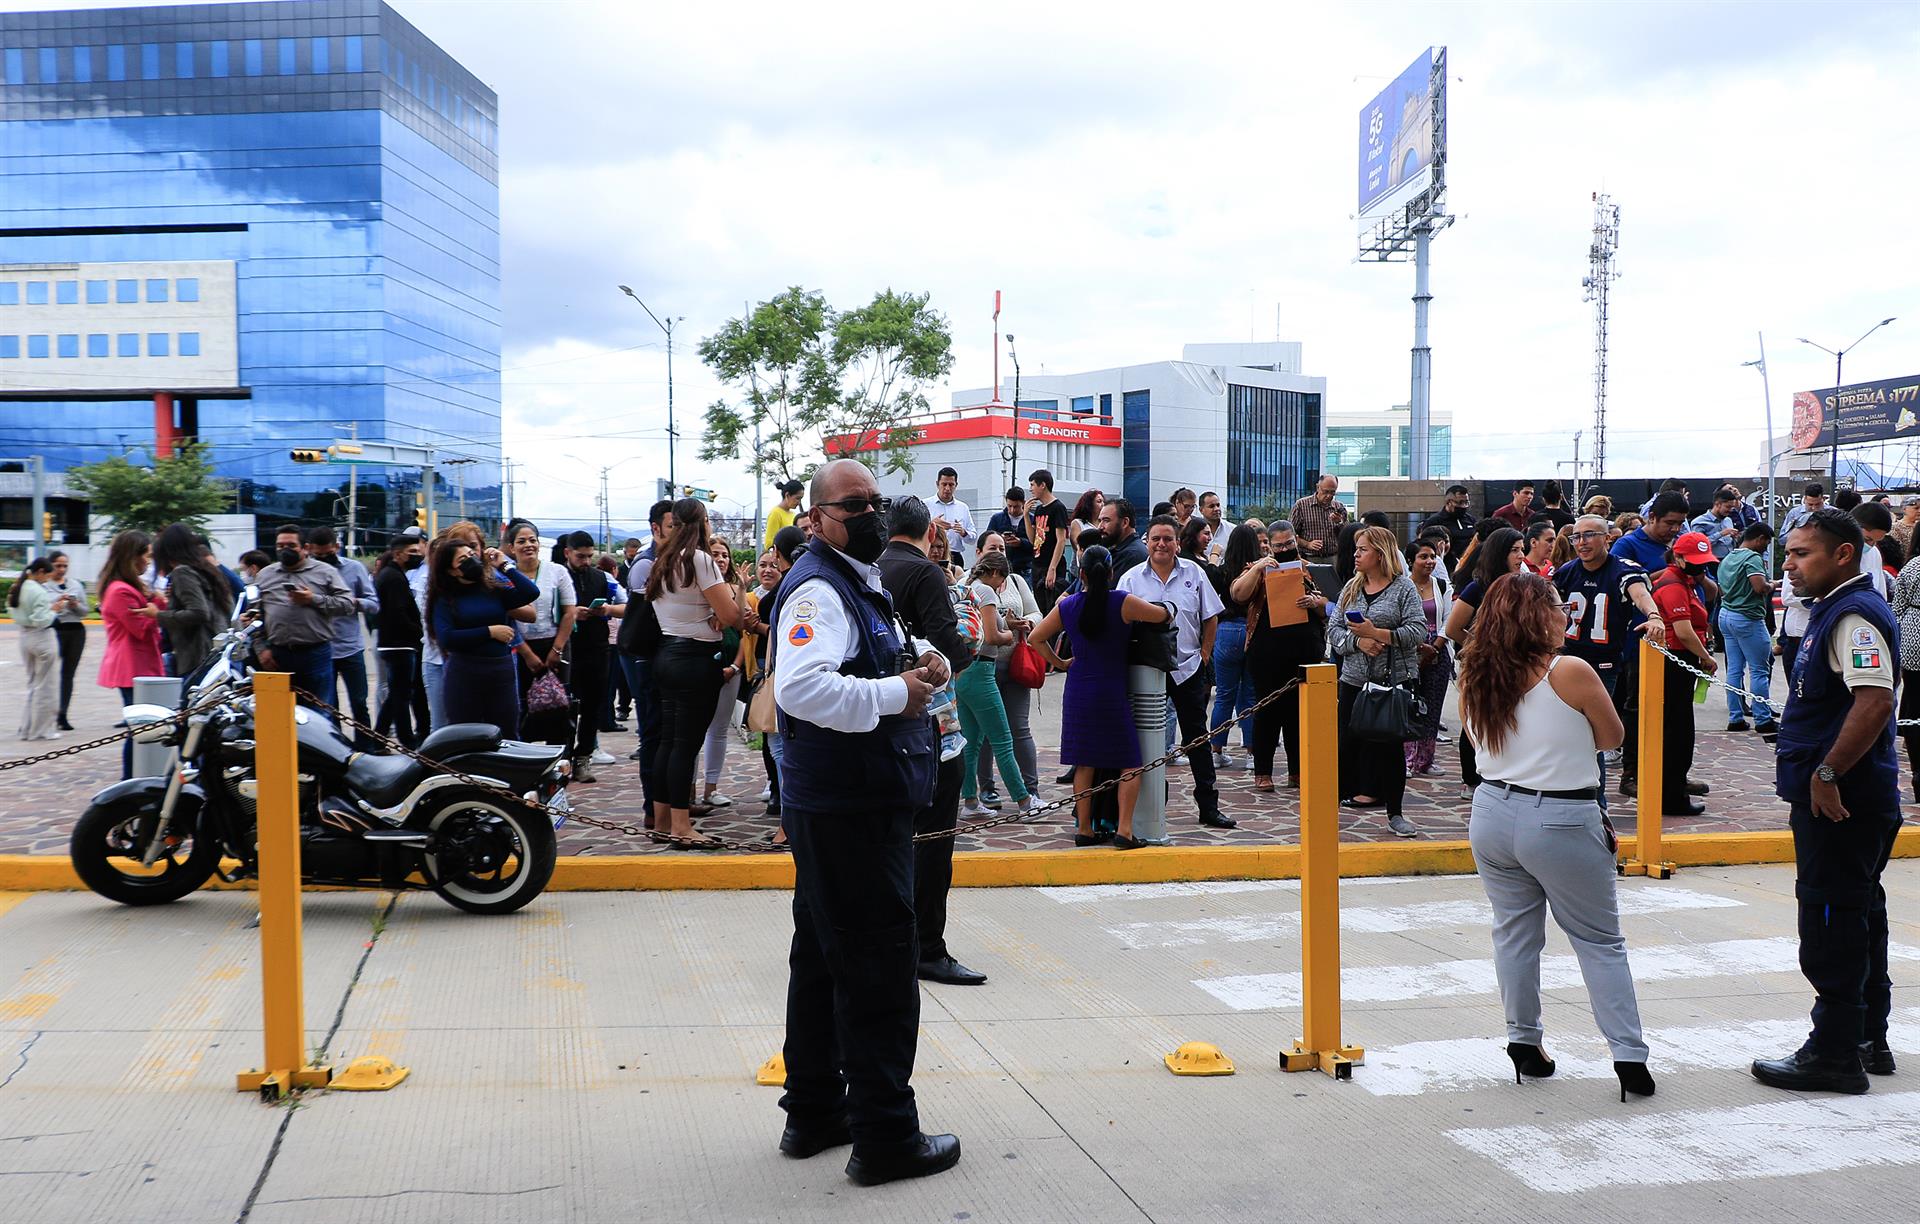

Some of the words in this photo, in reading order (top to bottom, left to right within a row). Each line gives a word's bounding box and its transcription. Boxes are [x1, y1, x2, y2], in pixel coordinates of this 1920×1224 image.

[1368, 112, 1383, 144] 5G
[1825, 388, 1886, 411] SUPREMA
[1042, 426, 1090, 439] BANORTE
[1565, 591, 1609, 643] 21
